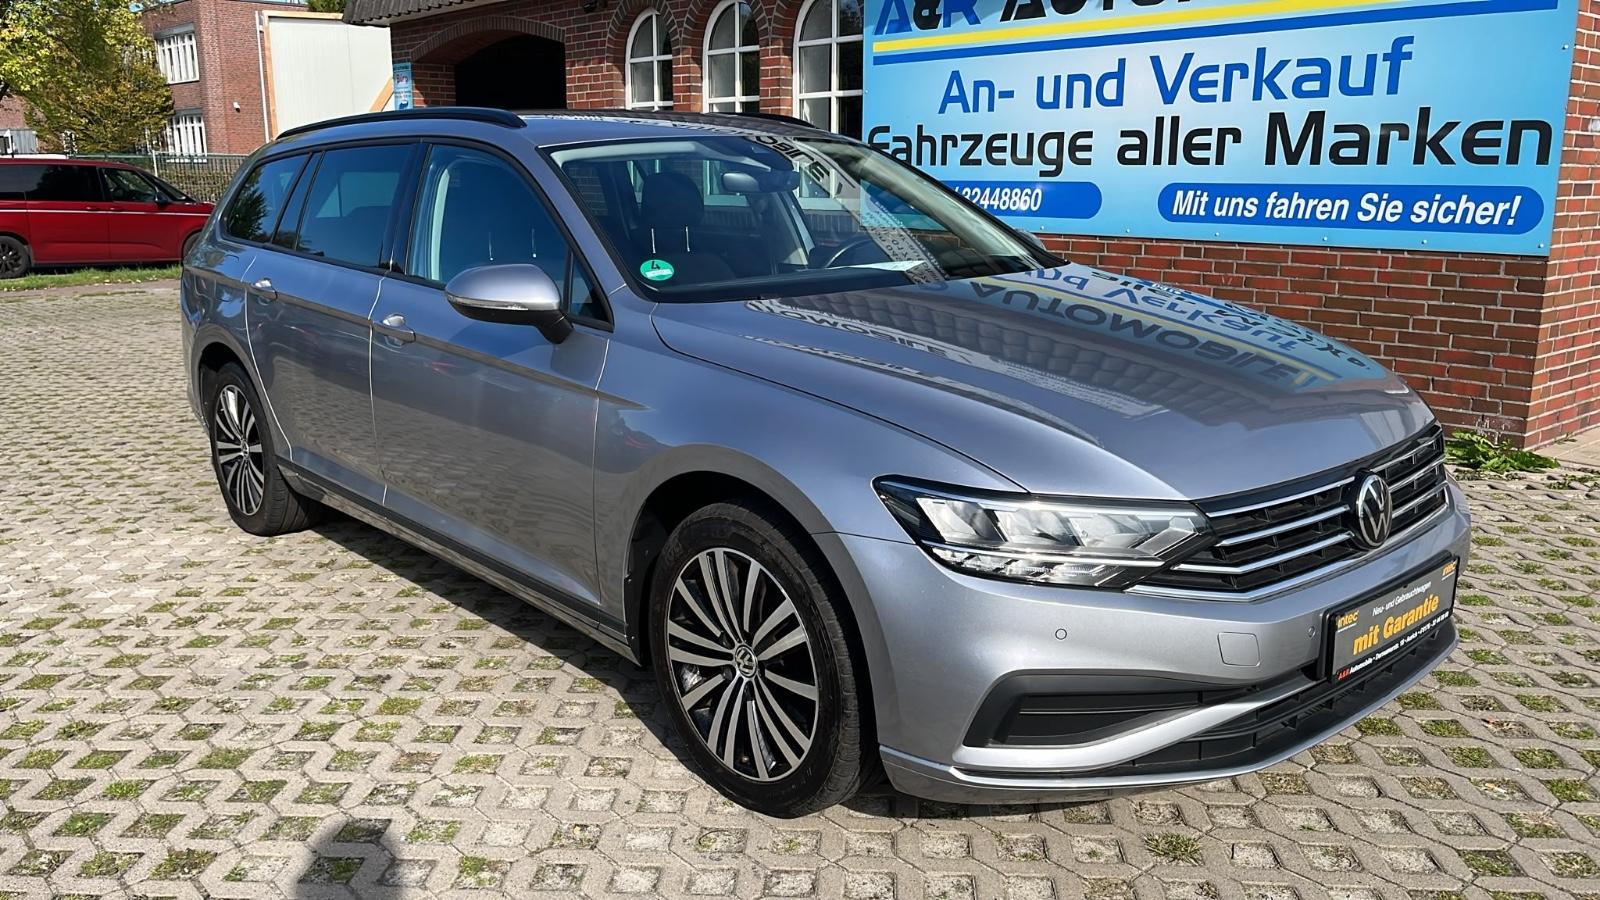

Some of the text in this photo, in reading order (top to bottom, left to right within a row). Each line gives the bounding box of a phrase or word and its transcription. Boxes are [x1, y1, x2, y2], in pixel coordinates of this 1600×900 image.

[938, 36, 1414, 114] An- und Verkauf
[868, 107, 1552, 177] Fahrzeuge aller Marken
[1172, 190, 1522, 226] Mit uns fahren Sie sicher!
[1353, 624, 1379, 655] mit
[1383, 594, 1439, 639] Garantie
